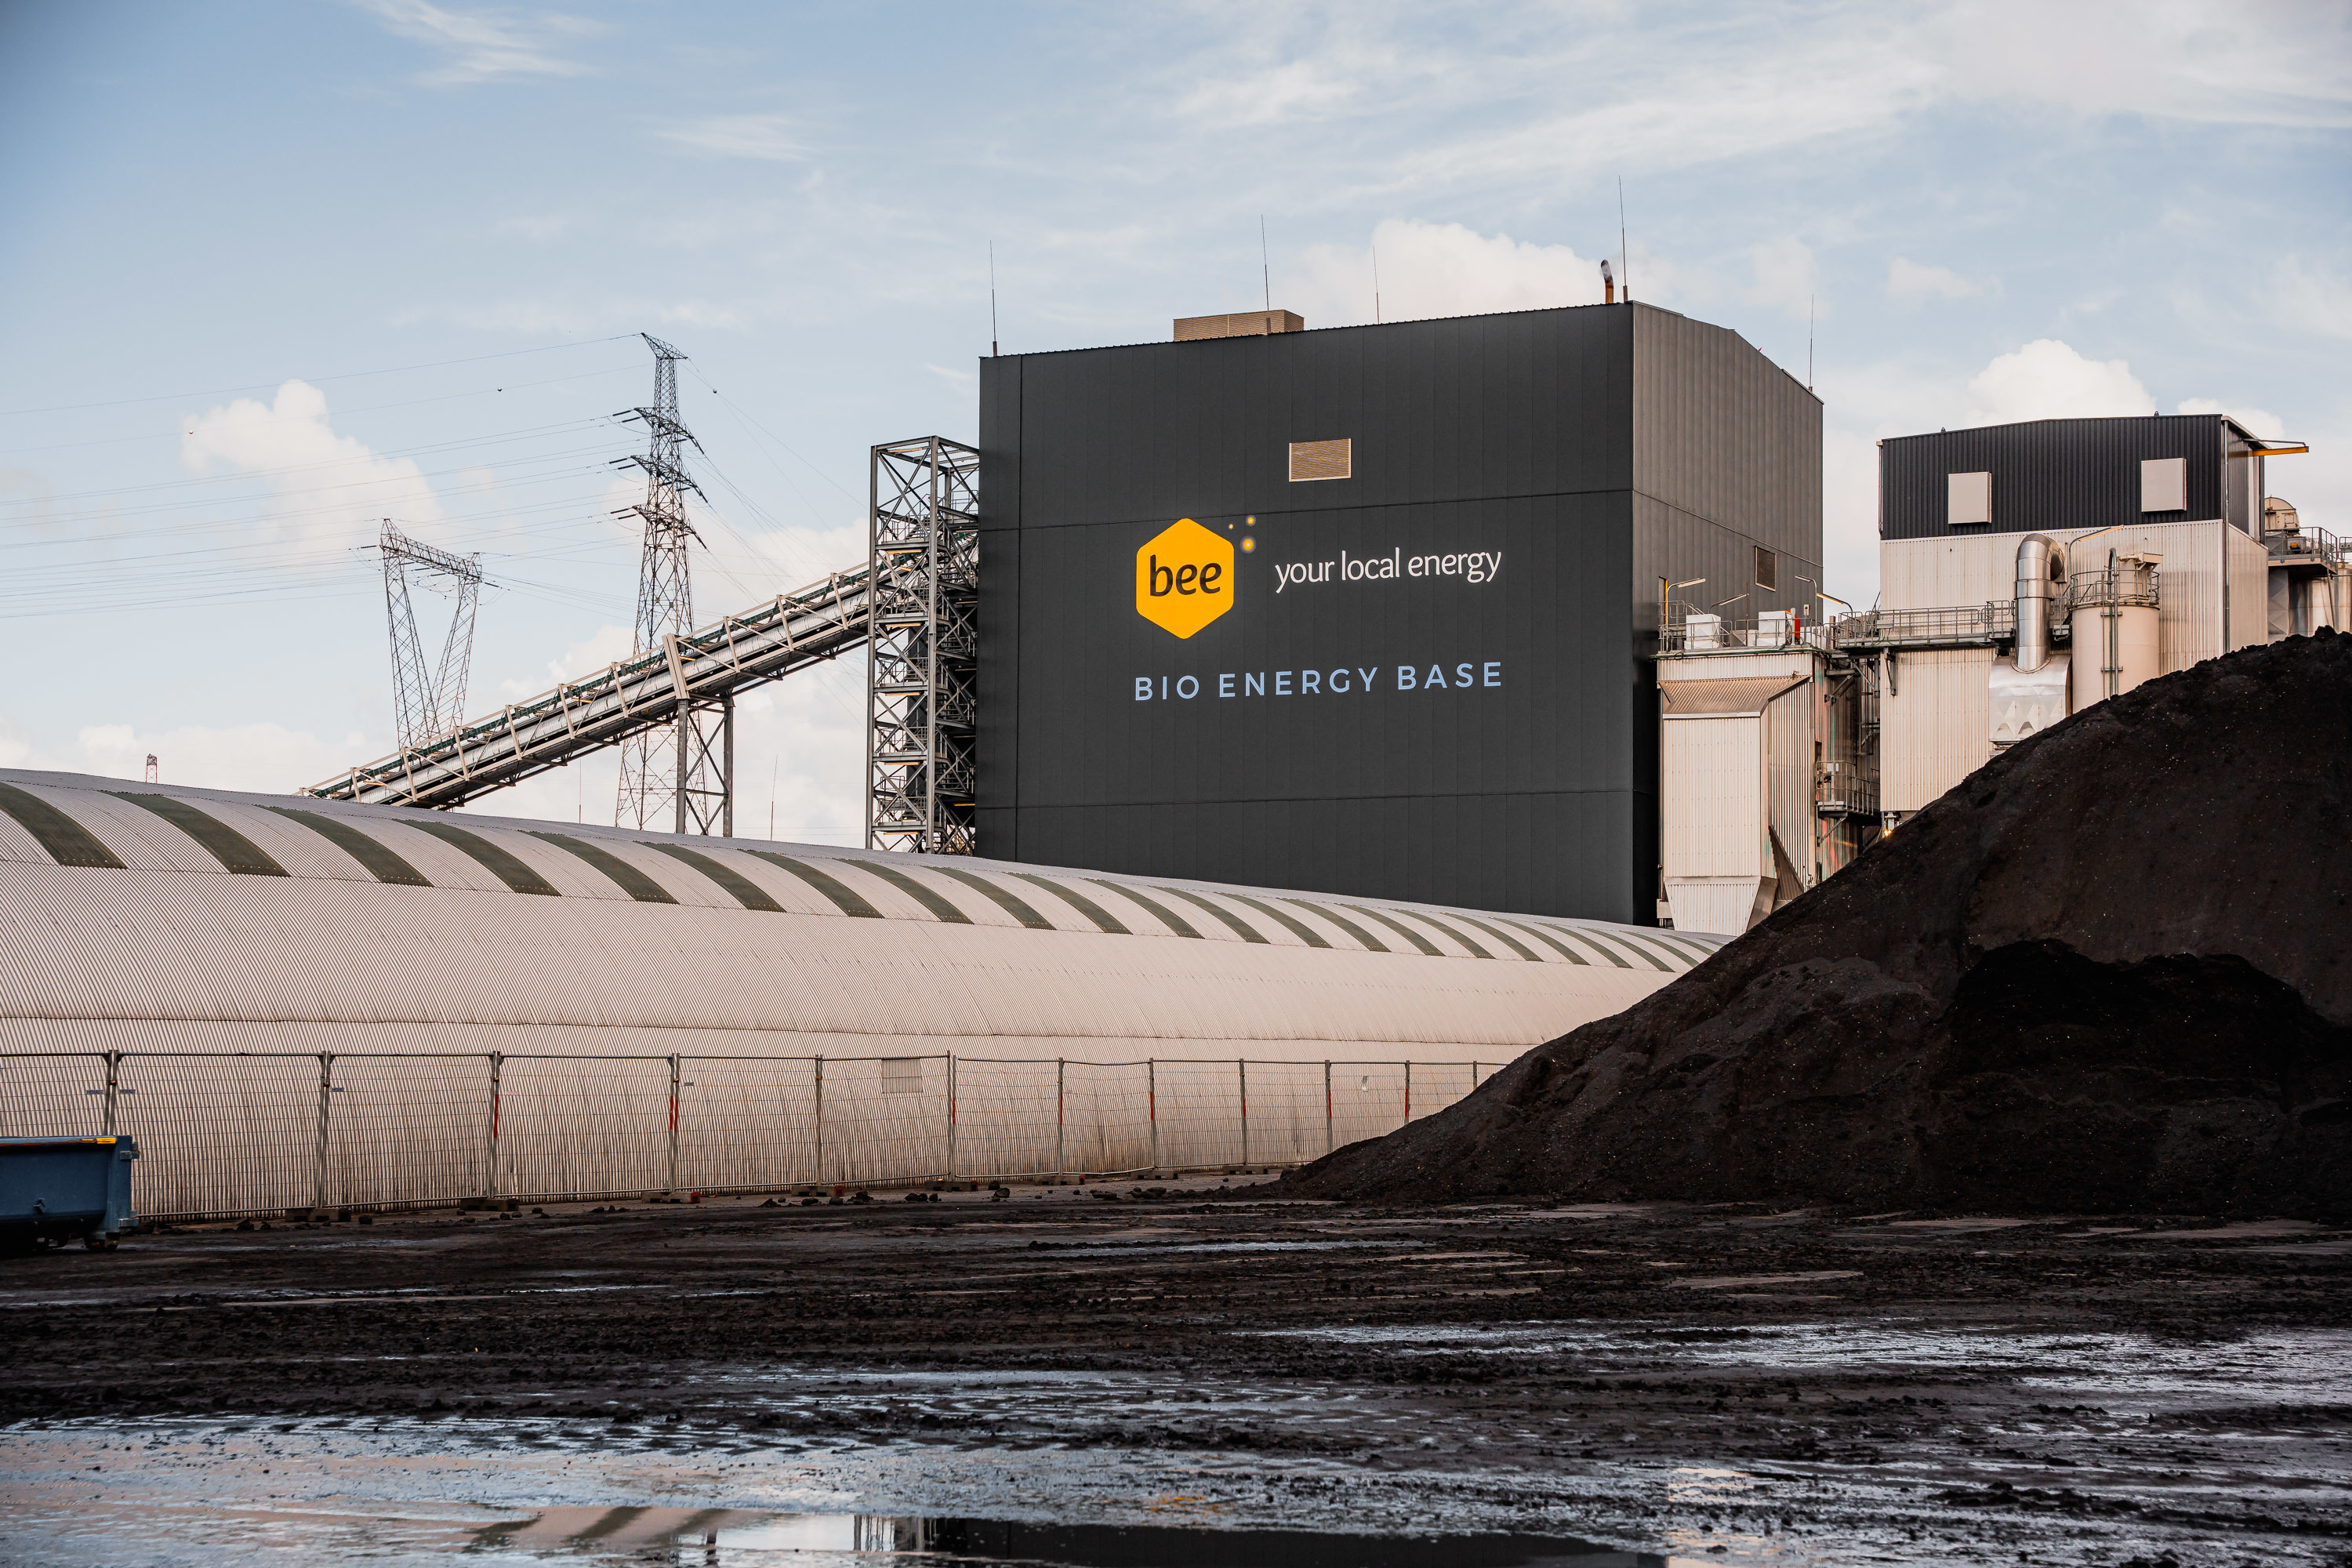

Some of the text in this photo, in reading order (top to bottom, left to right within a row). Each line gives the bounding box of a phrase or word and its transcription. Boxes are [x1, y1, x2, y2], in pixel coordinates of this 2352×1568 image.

[1149, 554, 1222, 597] bee
[1274, 546, 1502, 594] your local energy
[1134, 662, 1502, 701] BIO ENERGY BASE
